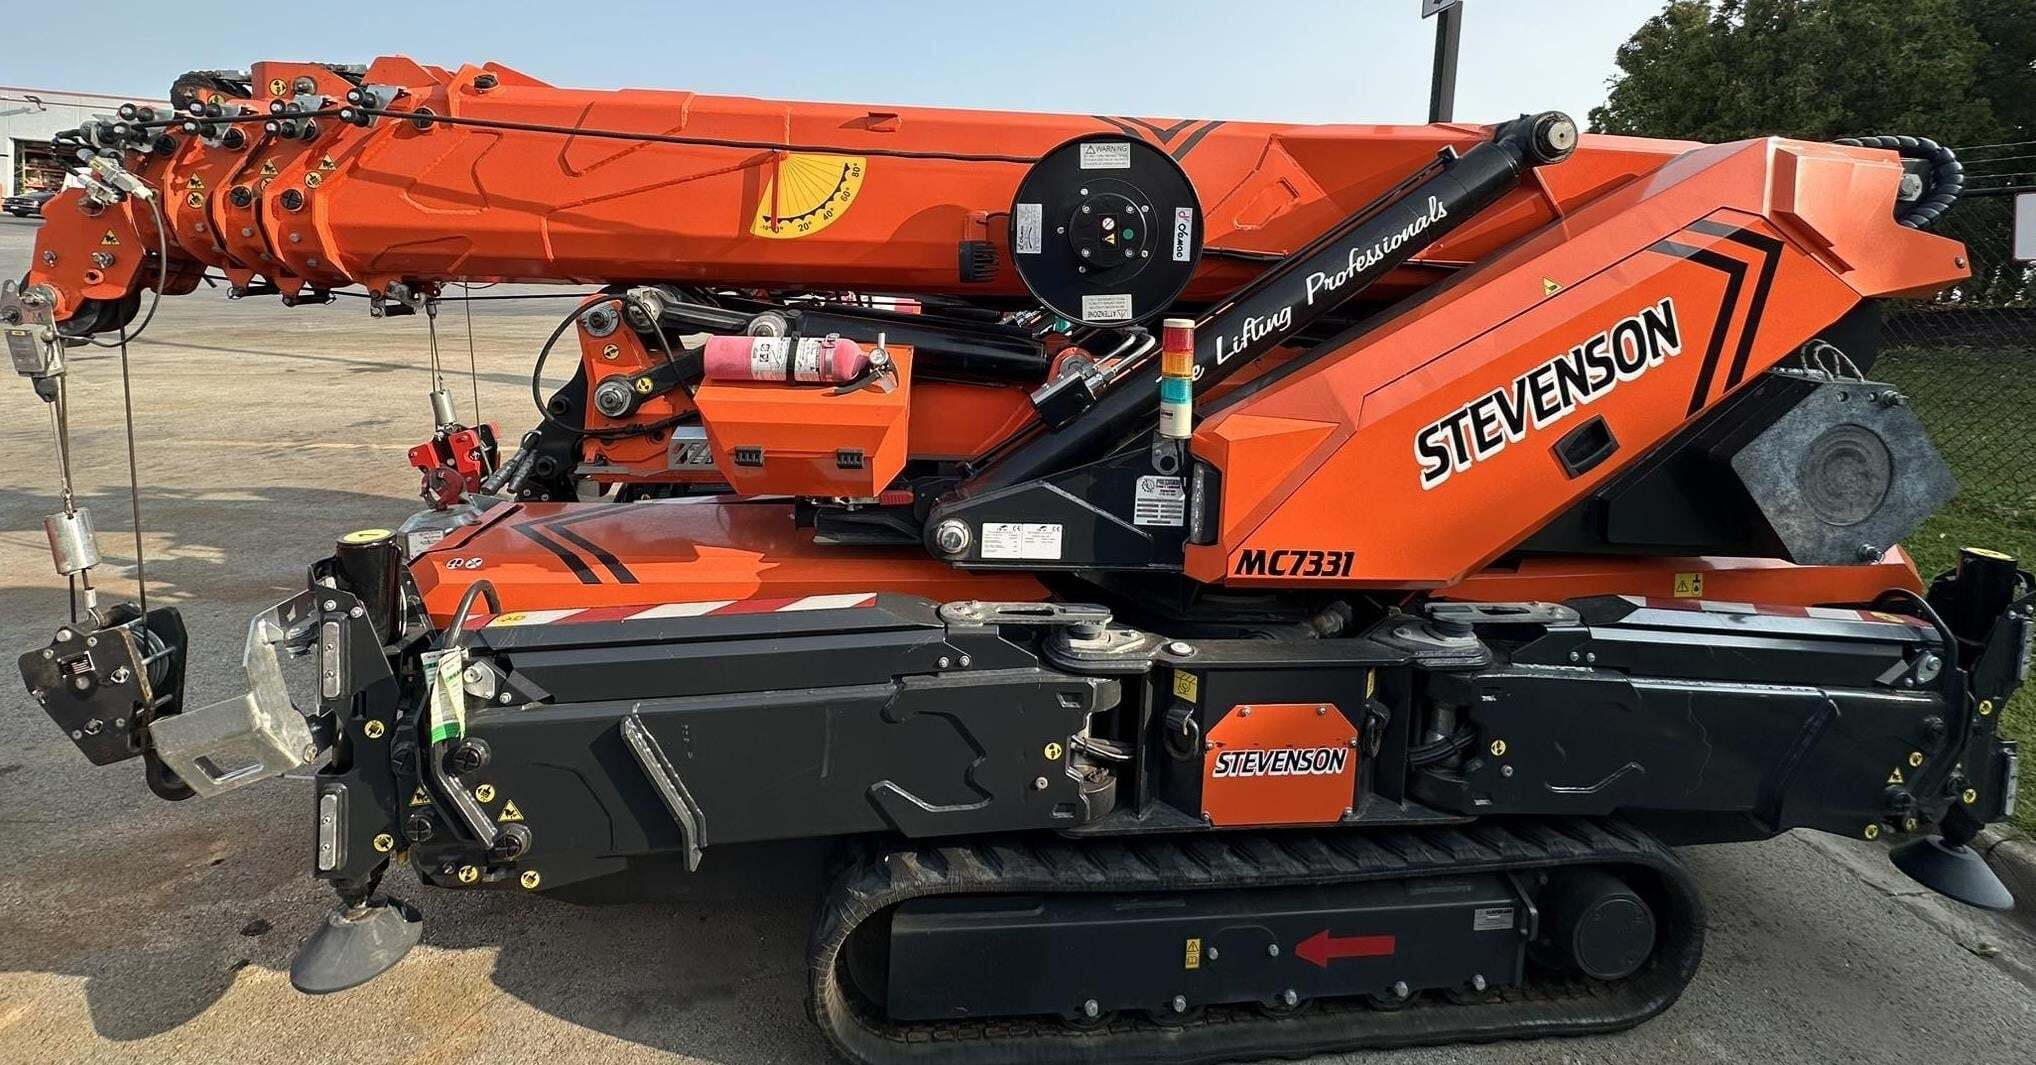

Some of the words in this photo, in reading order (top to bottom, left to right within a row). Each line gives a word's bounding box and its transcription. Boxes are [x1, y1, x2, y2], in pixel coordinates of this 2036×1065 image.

[1096, 144, 1128, 152] WARNING
[840, 187, 850, 201] 60°
[823, 207, 834, 220] 40°
[798, 221, 811, 232] 20°
[1216, 305, 1292, 365] Lifting
[1305, 195, 1447, 305] Professionals
[1416, 298, 1680, 487] STEVENSON
[1234, 549, 1355, 577] MC7331
[1213, 748, 1347, 777] STEVENSON
